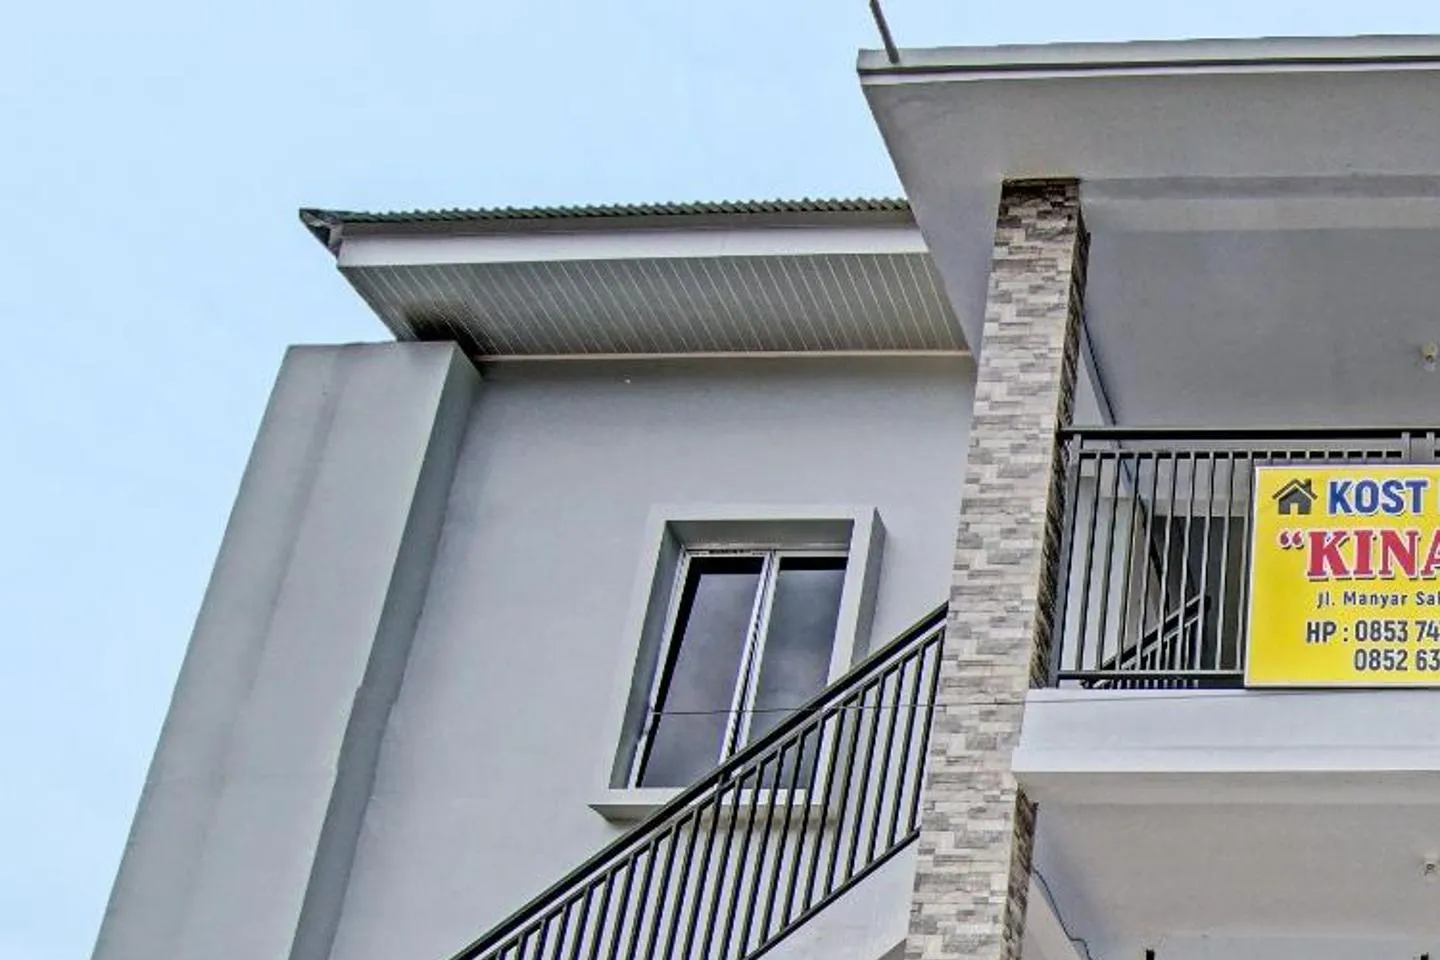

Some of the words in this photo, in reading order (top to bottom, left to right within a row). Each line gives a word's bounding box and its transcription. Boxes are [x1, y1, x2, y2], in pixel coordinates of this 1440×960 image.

[1328, 479, 1428, 515] KOST
[1317, 590, 1335, 609] Jl.
[1343, 591, 1408, 609] Manyar
[1355, 620, 1408, 642] 0853
[1354, 648, 1408, 671] 0852
